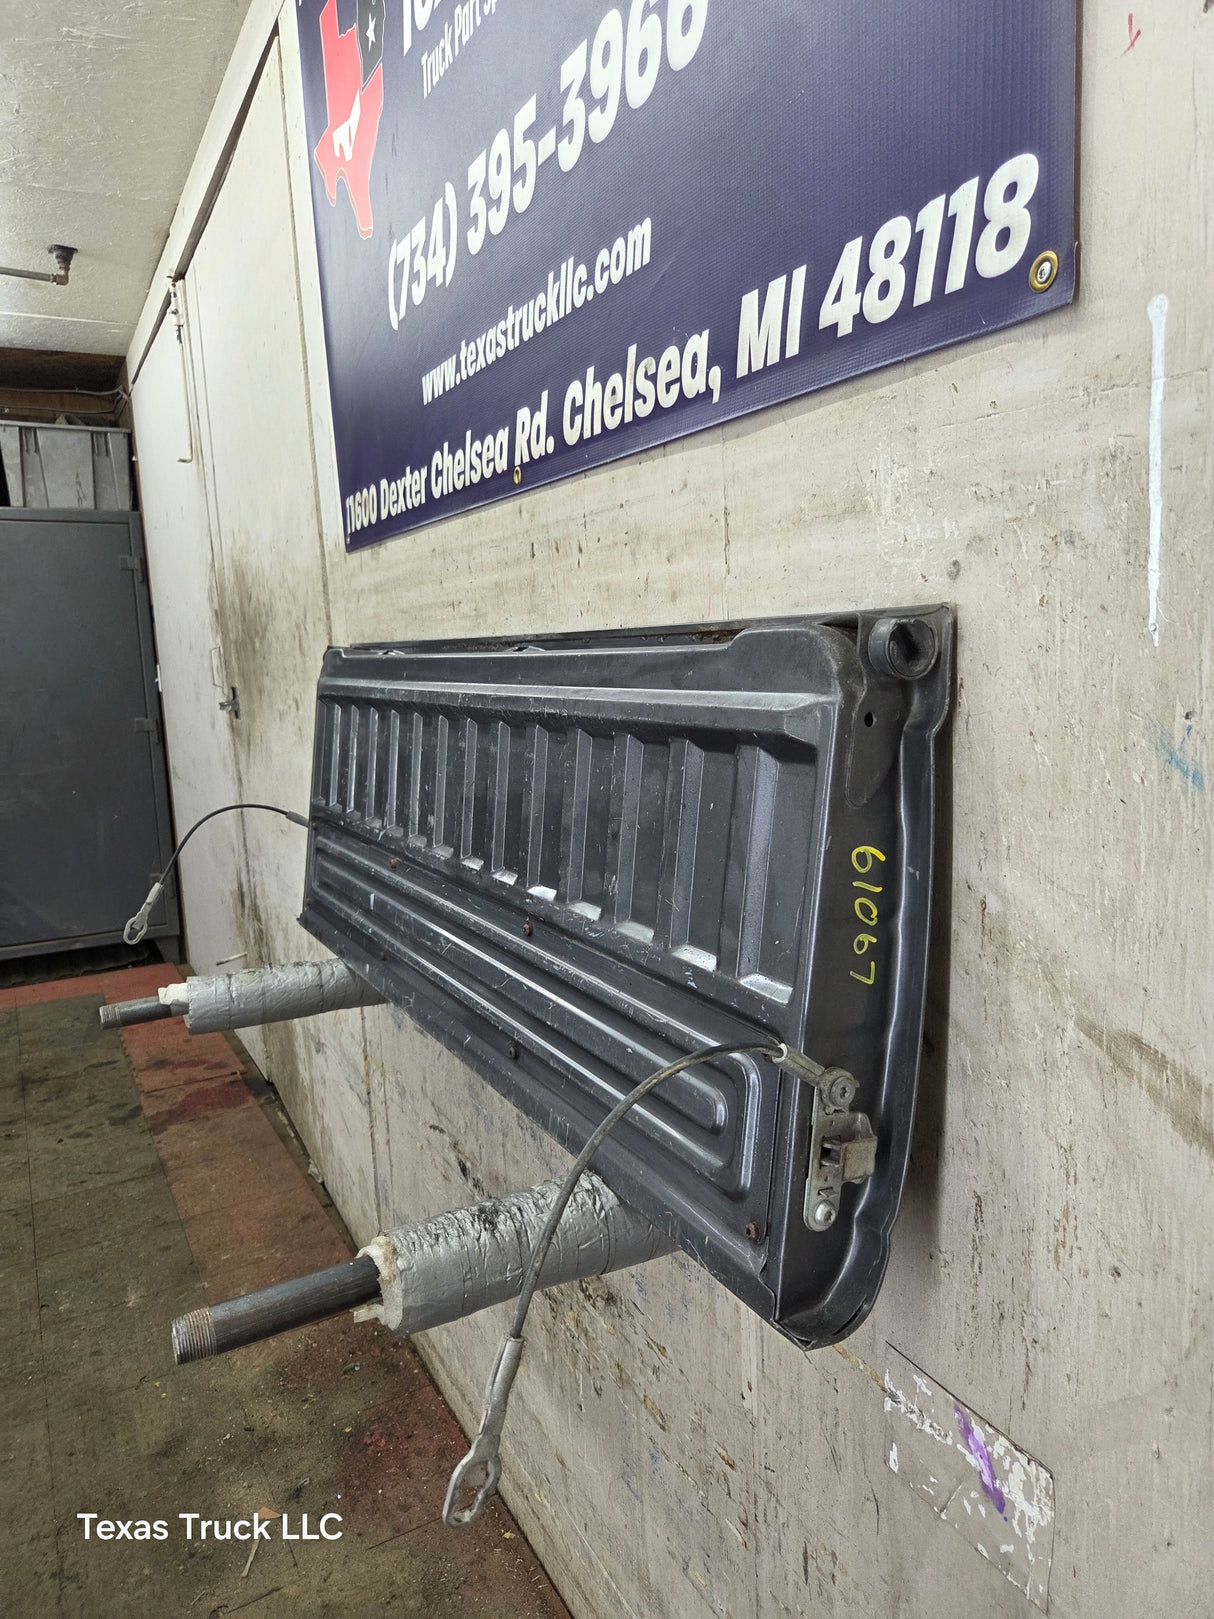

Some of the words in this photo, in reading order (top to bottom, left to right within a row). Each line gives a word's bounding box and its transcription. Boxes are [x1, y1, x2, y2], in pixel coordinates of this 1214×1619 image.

[421, 21, 453, 99] Truck
[388, 182, 458, 331] (734)
[422, 217, 651, 406] www.texastruckllc.com
[380, 465, 428, 520] Dexter
[431, 426, 509, 499] Chelsea
[514, 390, 555, 467] Rd.
[562, 329, 722, 446] Chelsea,
[736, 264, 807, 379] MI
[818, 153, 1039, 338] 48118
[850, 845, 886, 985] 61067
